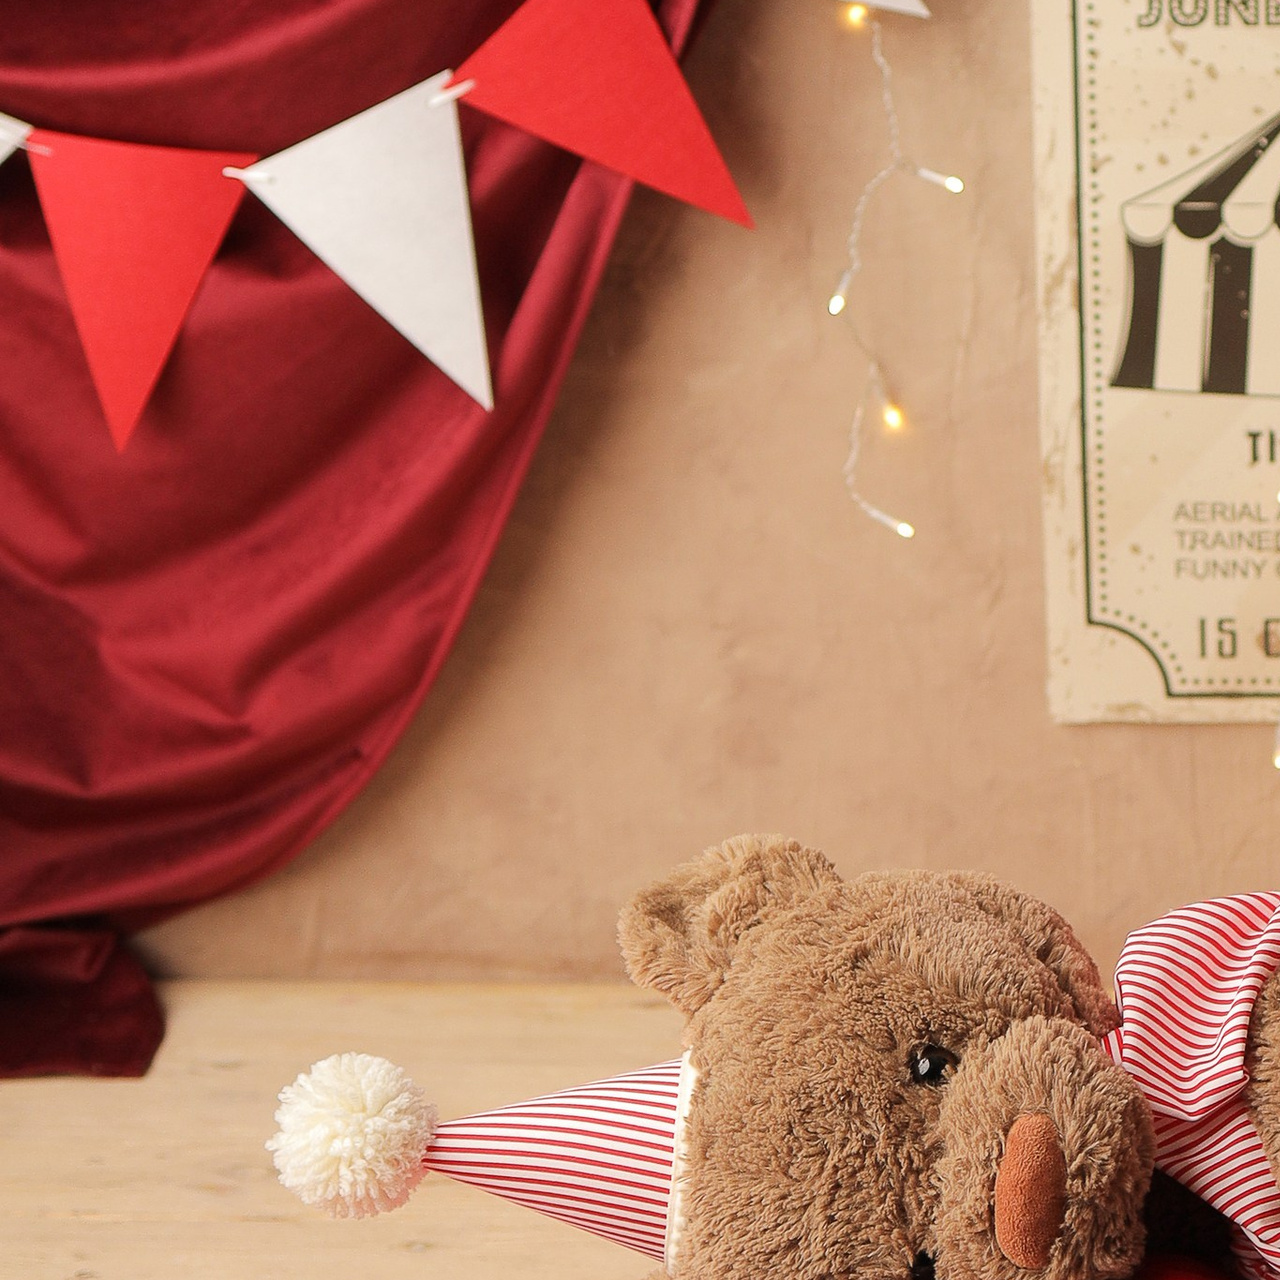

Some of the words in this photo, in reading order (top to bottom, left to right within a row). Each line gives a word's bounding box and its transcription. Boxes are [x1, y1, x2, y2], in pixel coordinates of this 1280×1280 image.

[1173, 502, 1263, 523] AERIAL
[1175, 559, 1267, 581] FUNNY
[1199, 619, 1238, 659] IS
